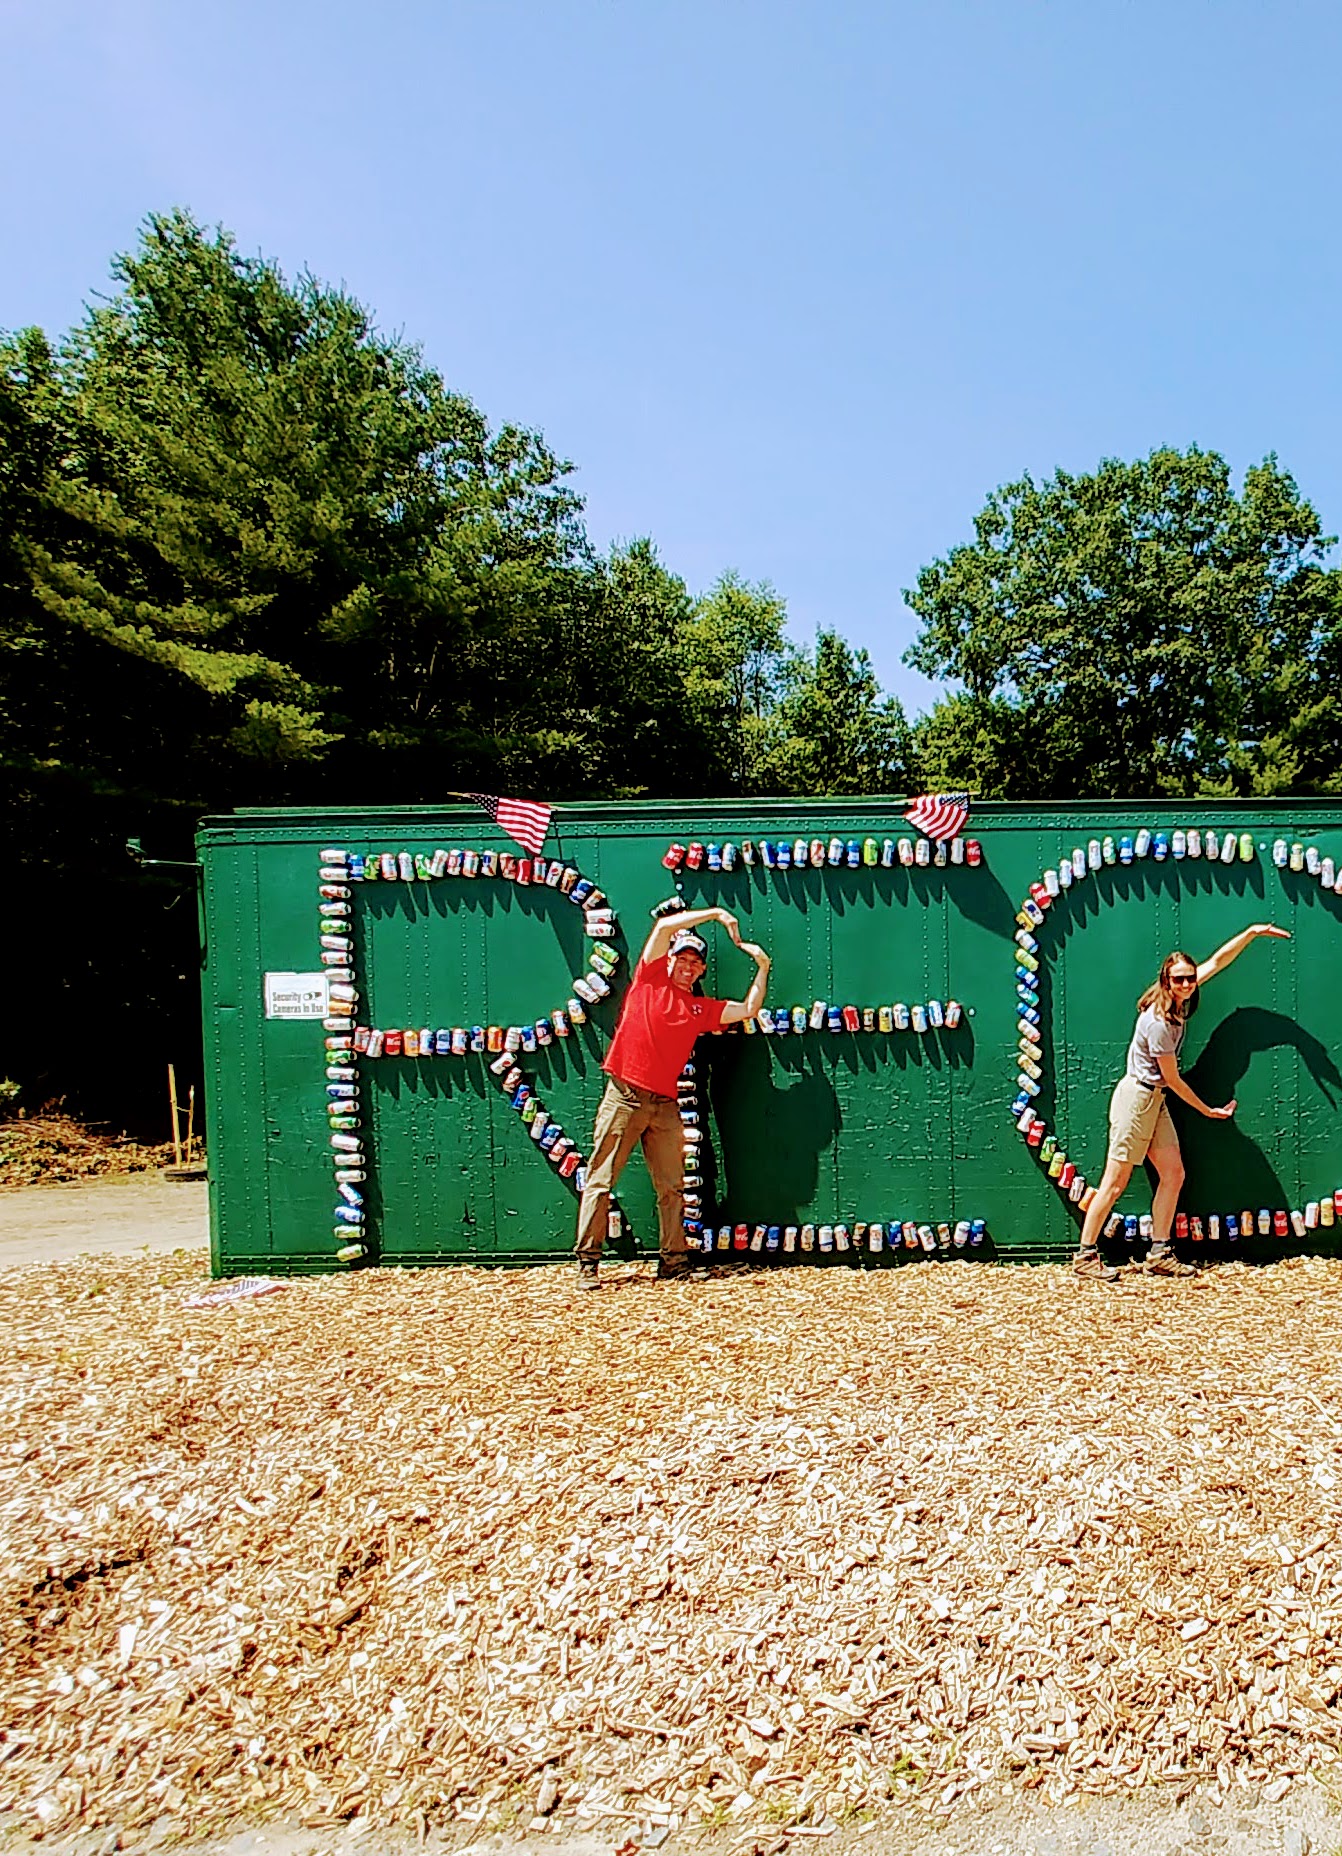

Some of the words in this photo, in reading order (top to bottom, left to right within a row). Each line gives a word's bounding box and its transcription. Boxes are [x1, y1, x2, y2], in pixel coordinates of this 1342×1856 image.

[272, 991, 301, 1003] Security
[272, 1003, 302, 1013] Cameras
[311, 1003, 324, 1013] Use
